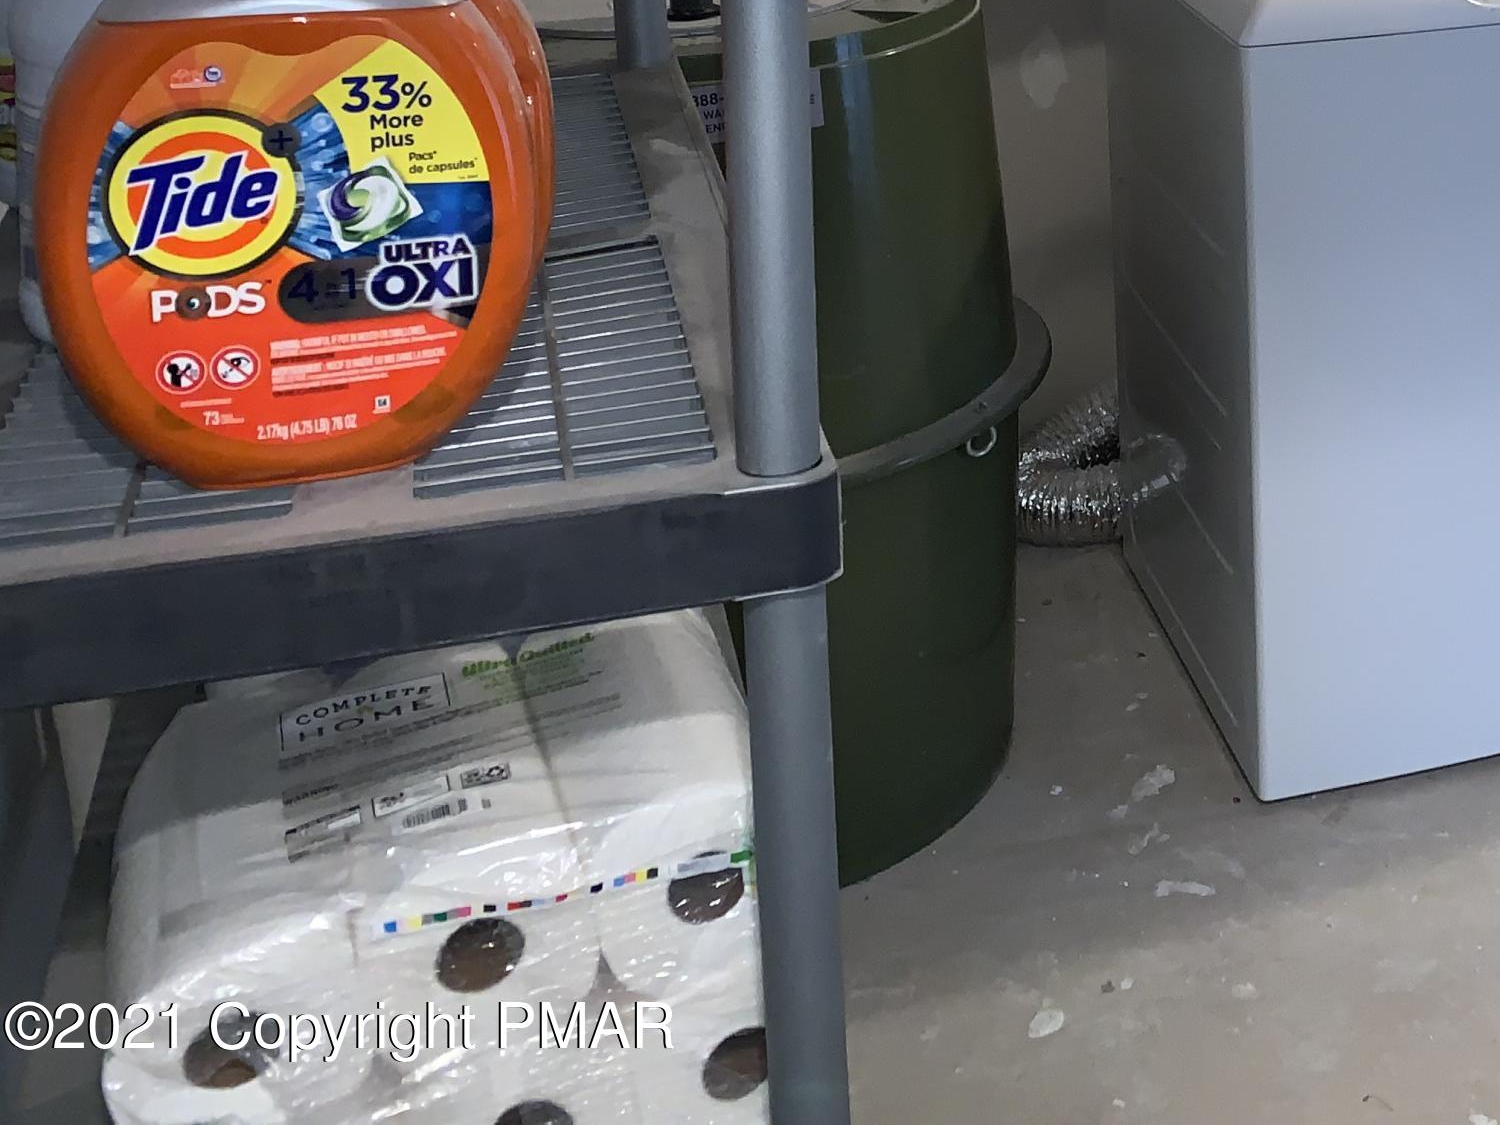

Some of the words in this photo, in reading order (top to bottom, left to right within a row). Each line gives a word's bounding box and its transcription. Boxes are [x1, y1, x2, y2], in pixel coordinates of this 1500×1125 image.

[341, 73, 432, 113] 33%
[369, 113, 424, 130] More
[703, 108, 725, 120] WA
[370, 131, 414, 152] plus
[408, 164, 424, 174] de
[126, 153, 279, 252] Tide
[383, 237, 472, 263] ULTRA
[370, 256, 475, 306] OXI
[151, 281, 266, 323] PODS
[202, 410, 221, 426] 73
[257, 423, 289, 441] 2.17kg
[295, 685, 432, 725] COMPLETE
[299, 695, 434, 742] HOME
